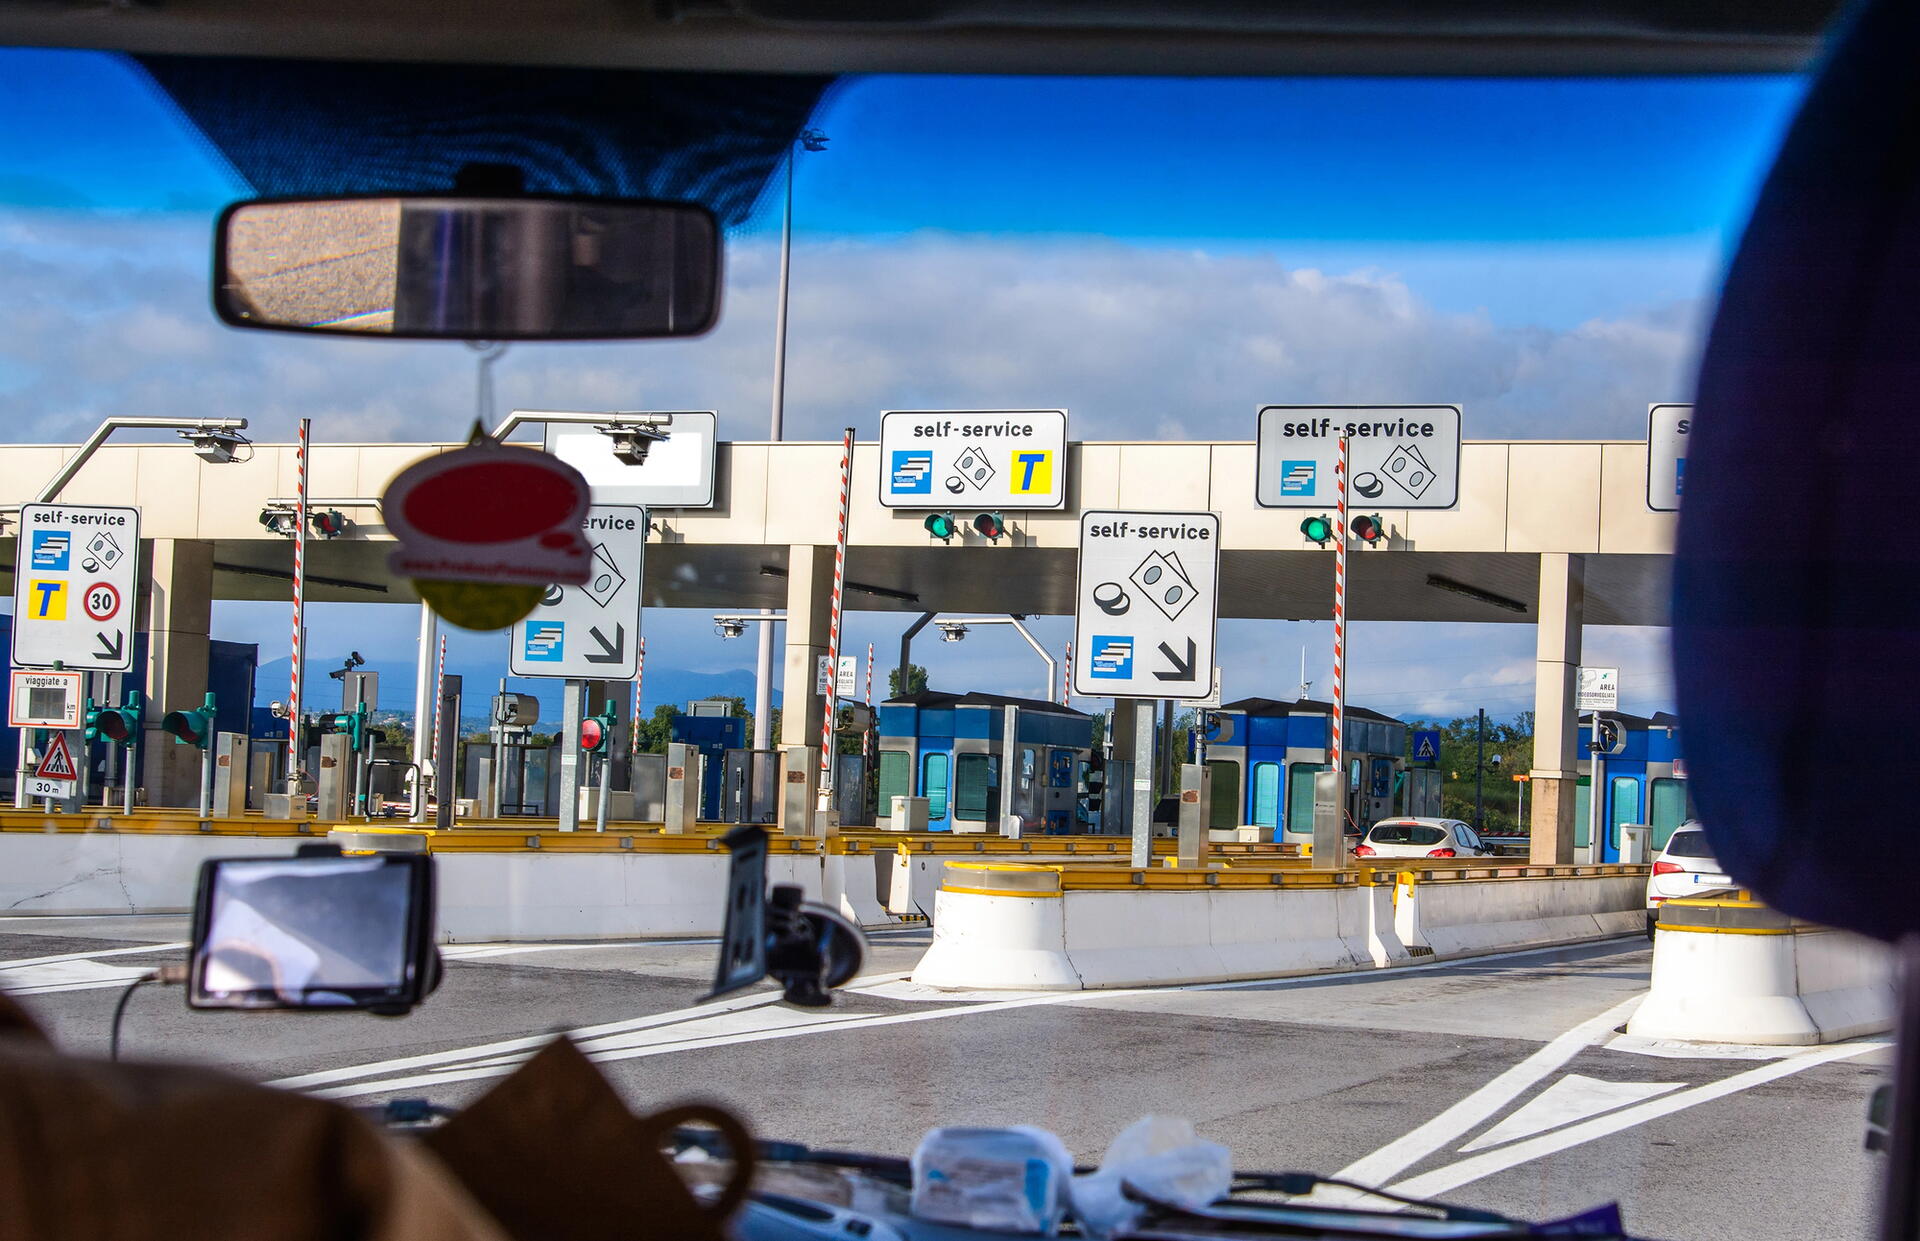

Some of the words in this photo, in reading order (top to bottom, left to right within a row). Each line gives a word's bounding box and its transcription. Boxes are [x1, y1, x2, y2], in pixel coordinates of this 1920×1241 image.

[913, 421, 1033, 437] self-service
[1283, 418, 1434, 437] self-service
[1018, 454, 1045, 490] T
[33, 510, 125, 526] self-service
[582, 515, 636, 530] ervice
[1090, 522, 1210, 540] self-service
[37, 583, 61, 616] T
[91, 593, 112, 610] 30
[25, 675, 60, 687] viaggiate
[63, 678, 68, 686] a
[36, 782, 51, 793] 30
